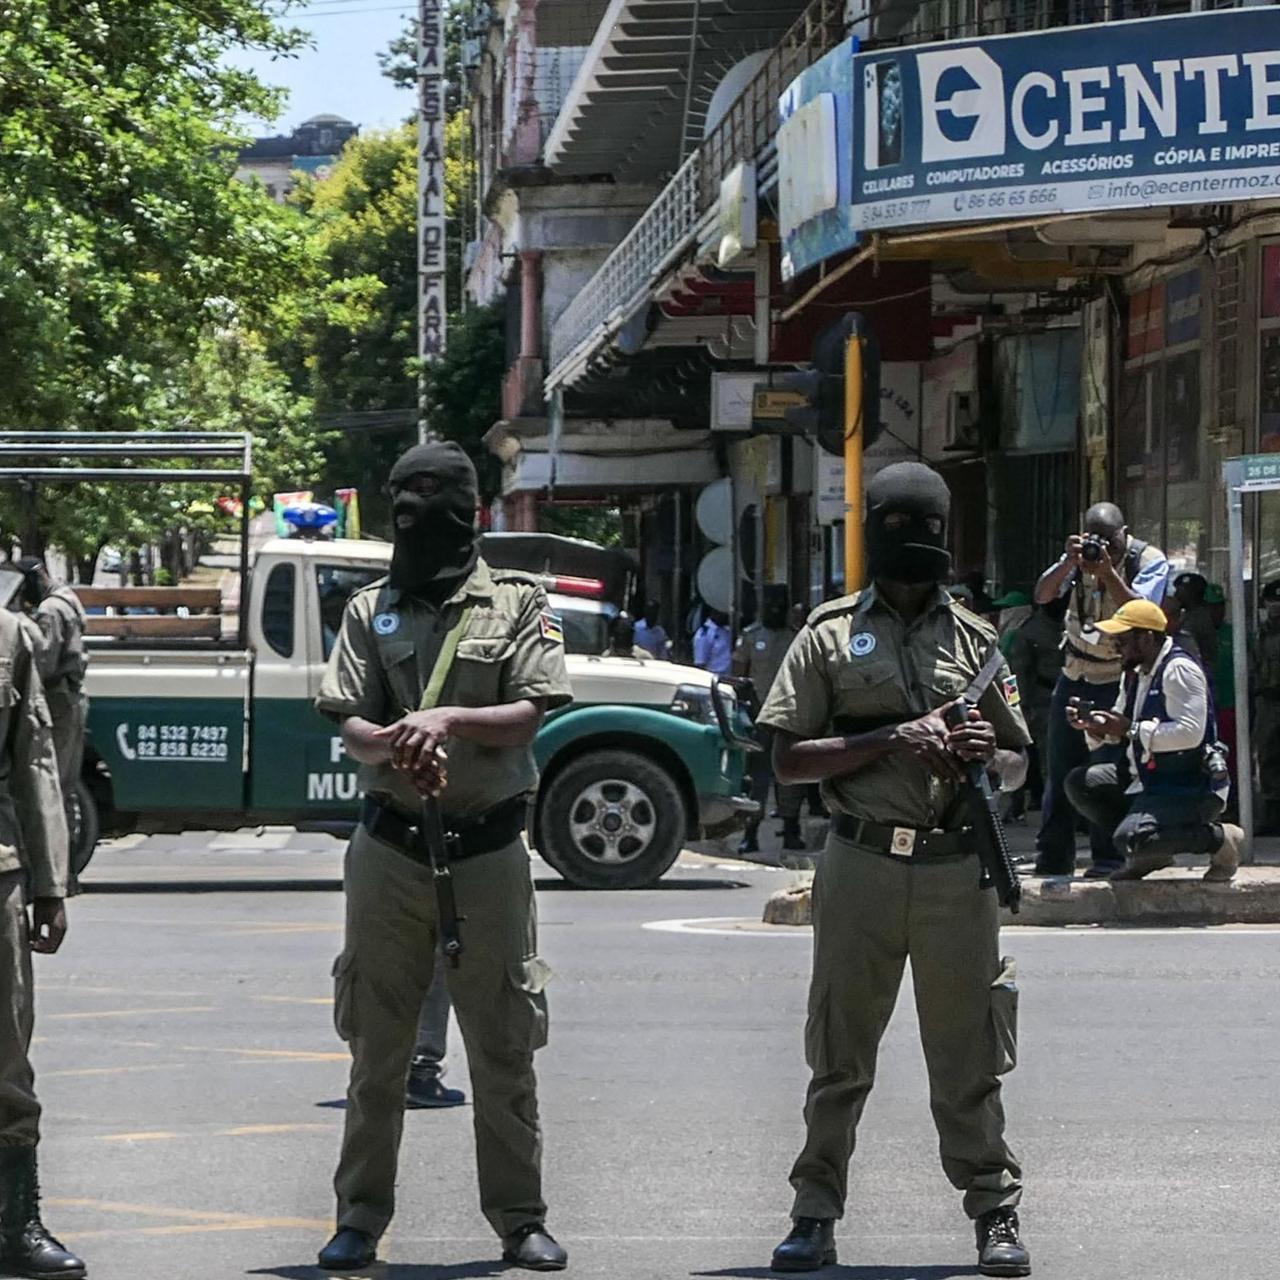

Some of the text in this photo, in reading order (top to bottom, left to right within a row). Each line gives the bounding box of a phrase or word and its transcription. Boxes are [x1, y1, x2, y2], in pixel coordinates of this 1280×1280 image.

[422, 76, 441, 217] ESTATAL
[862, 174, 915, 195] CELULARES
[926, 163, 1025, 186] COMPUTADORES
[1041, 153, 1134, 175] ACESSÓRIOS
[1154, 147, 1206, 165] CÓPIA
[1210, 148, 1222, 161] E
[423, 227, 441, 265] DE
[307, 772, 365, 800] MU
